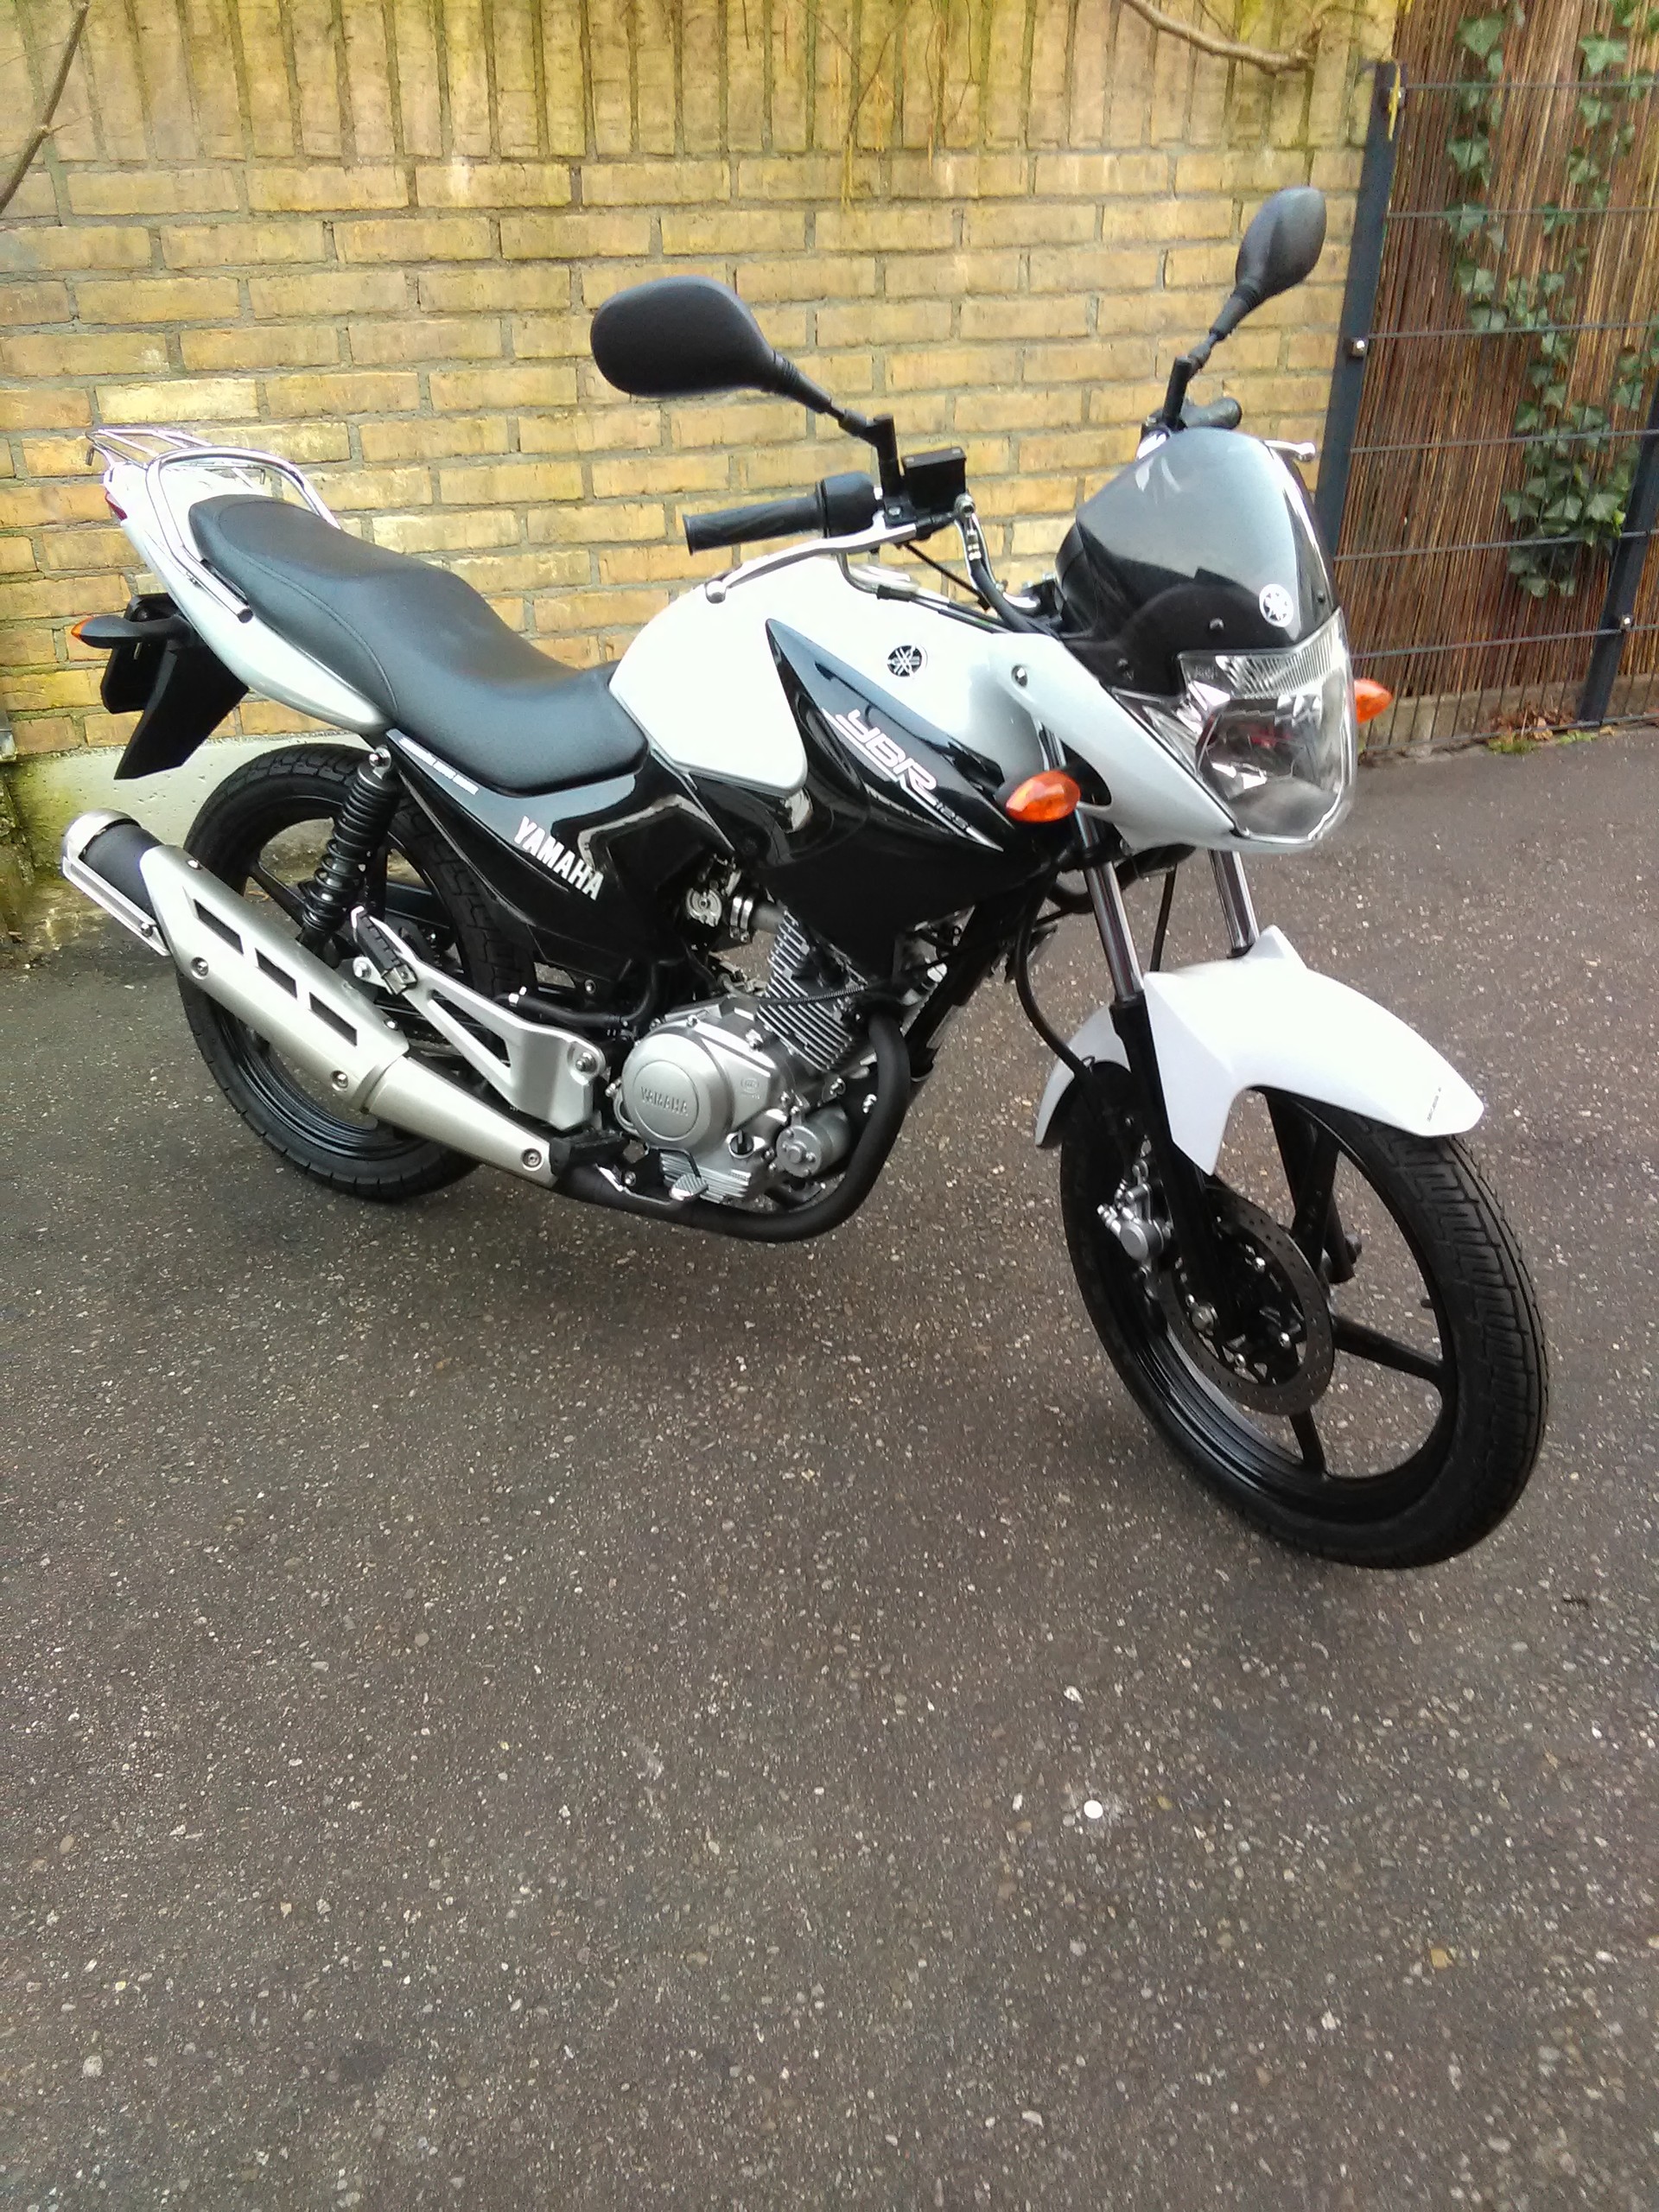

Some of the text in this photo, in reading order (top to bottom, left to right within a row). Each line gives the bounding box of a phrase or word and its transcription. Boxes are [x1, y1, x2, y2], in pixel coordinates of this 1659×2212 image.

[835, 708, 939, 806] YBR
[514, 816, 604, 900] YAMAHA
[640, 1086, 689, 1116] YAMAHA
